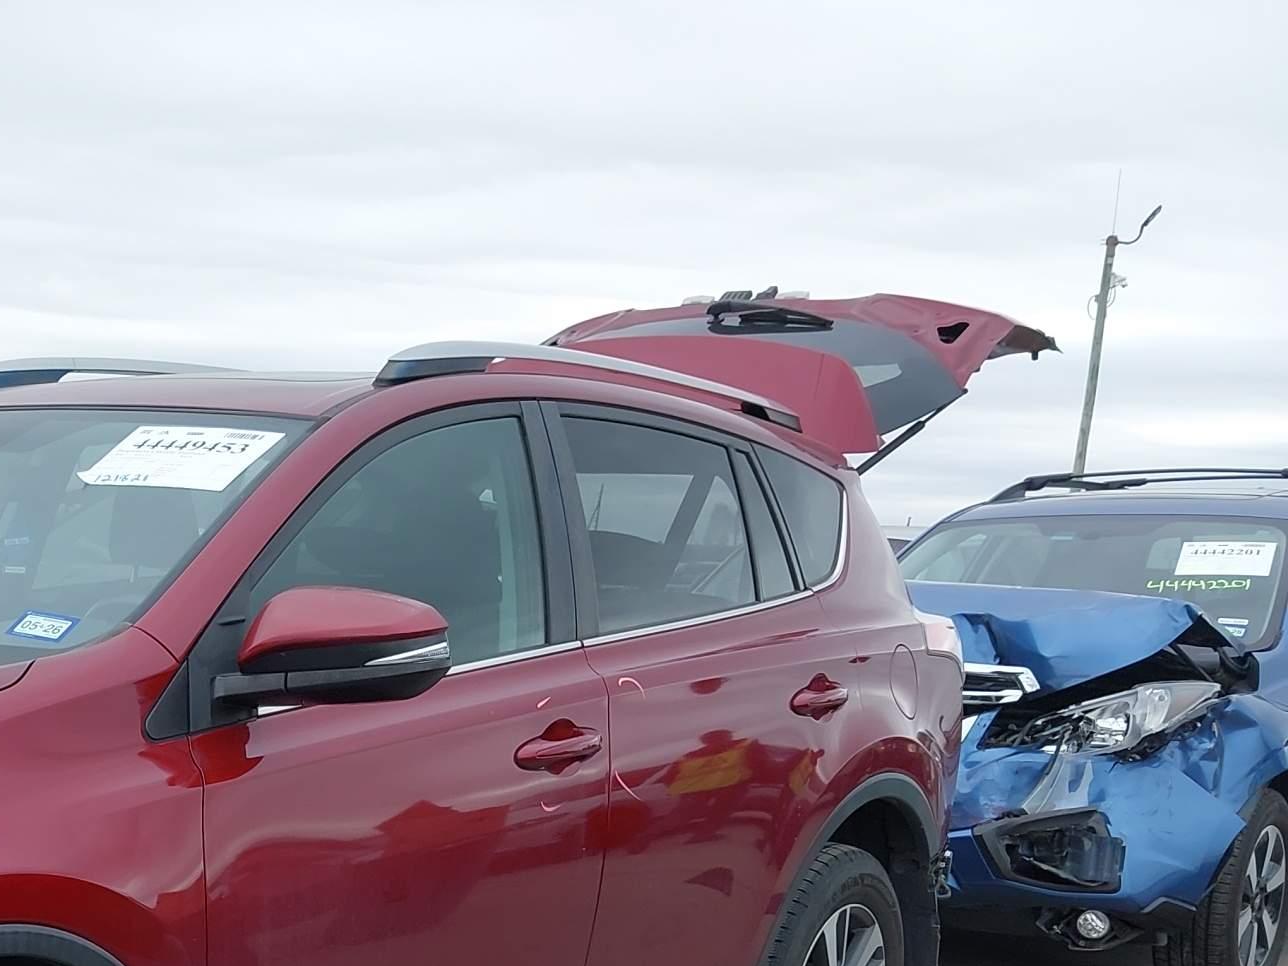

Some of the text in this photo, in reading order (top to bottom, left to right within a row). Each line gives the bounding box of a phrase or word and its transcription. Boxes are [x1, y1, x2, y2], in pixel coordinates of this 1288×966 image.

[133, 438, 250, 455] 44449453
[1191, 548, 1261, 556] 44442201
[1146, 578, 1252, 593] 44442201
